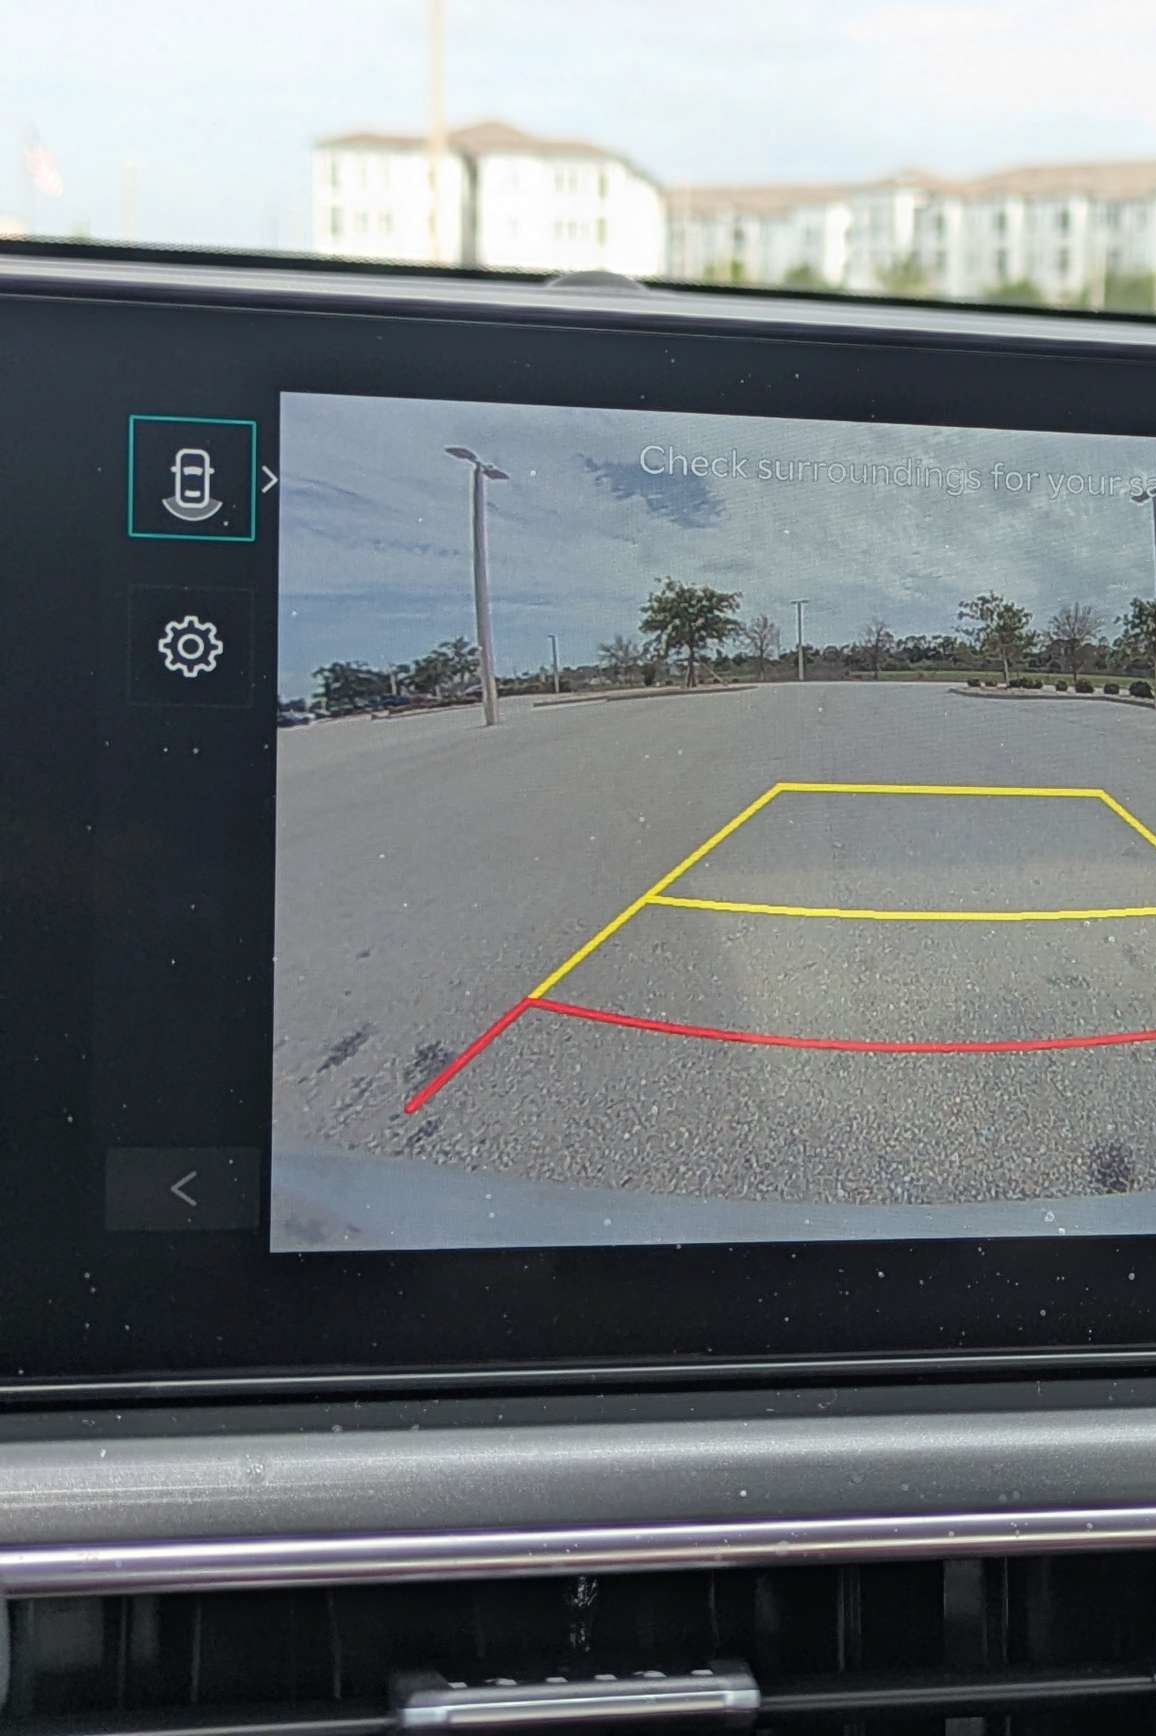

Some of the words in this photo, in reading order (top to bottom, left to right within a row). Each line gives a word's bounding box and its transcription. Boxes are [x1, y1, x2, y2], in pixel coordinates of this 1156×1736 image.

[639, 445, 748, 478] Check
[758, 456, 982, 496] surroundings
[991, 462, 1040, 492] for
[1048, 473, 1122, 498] your
